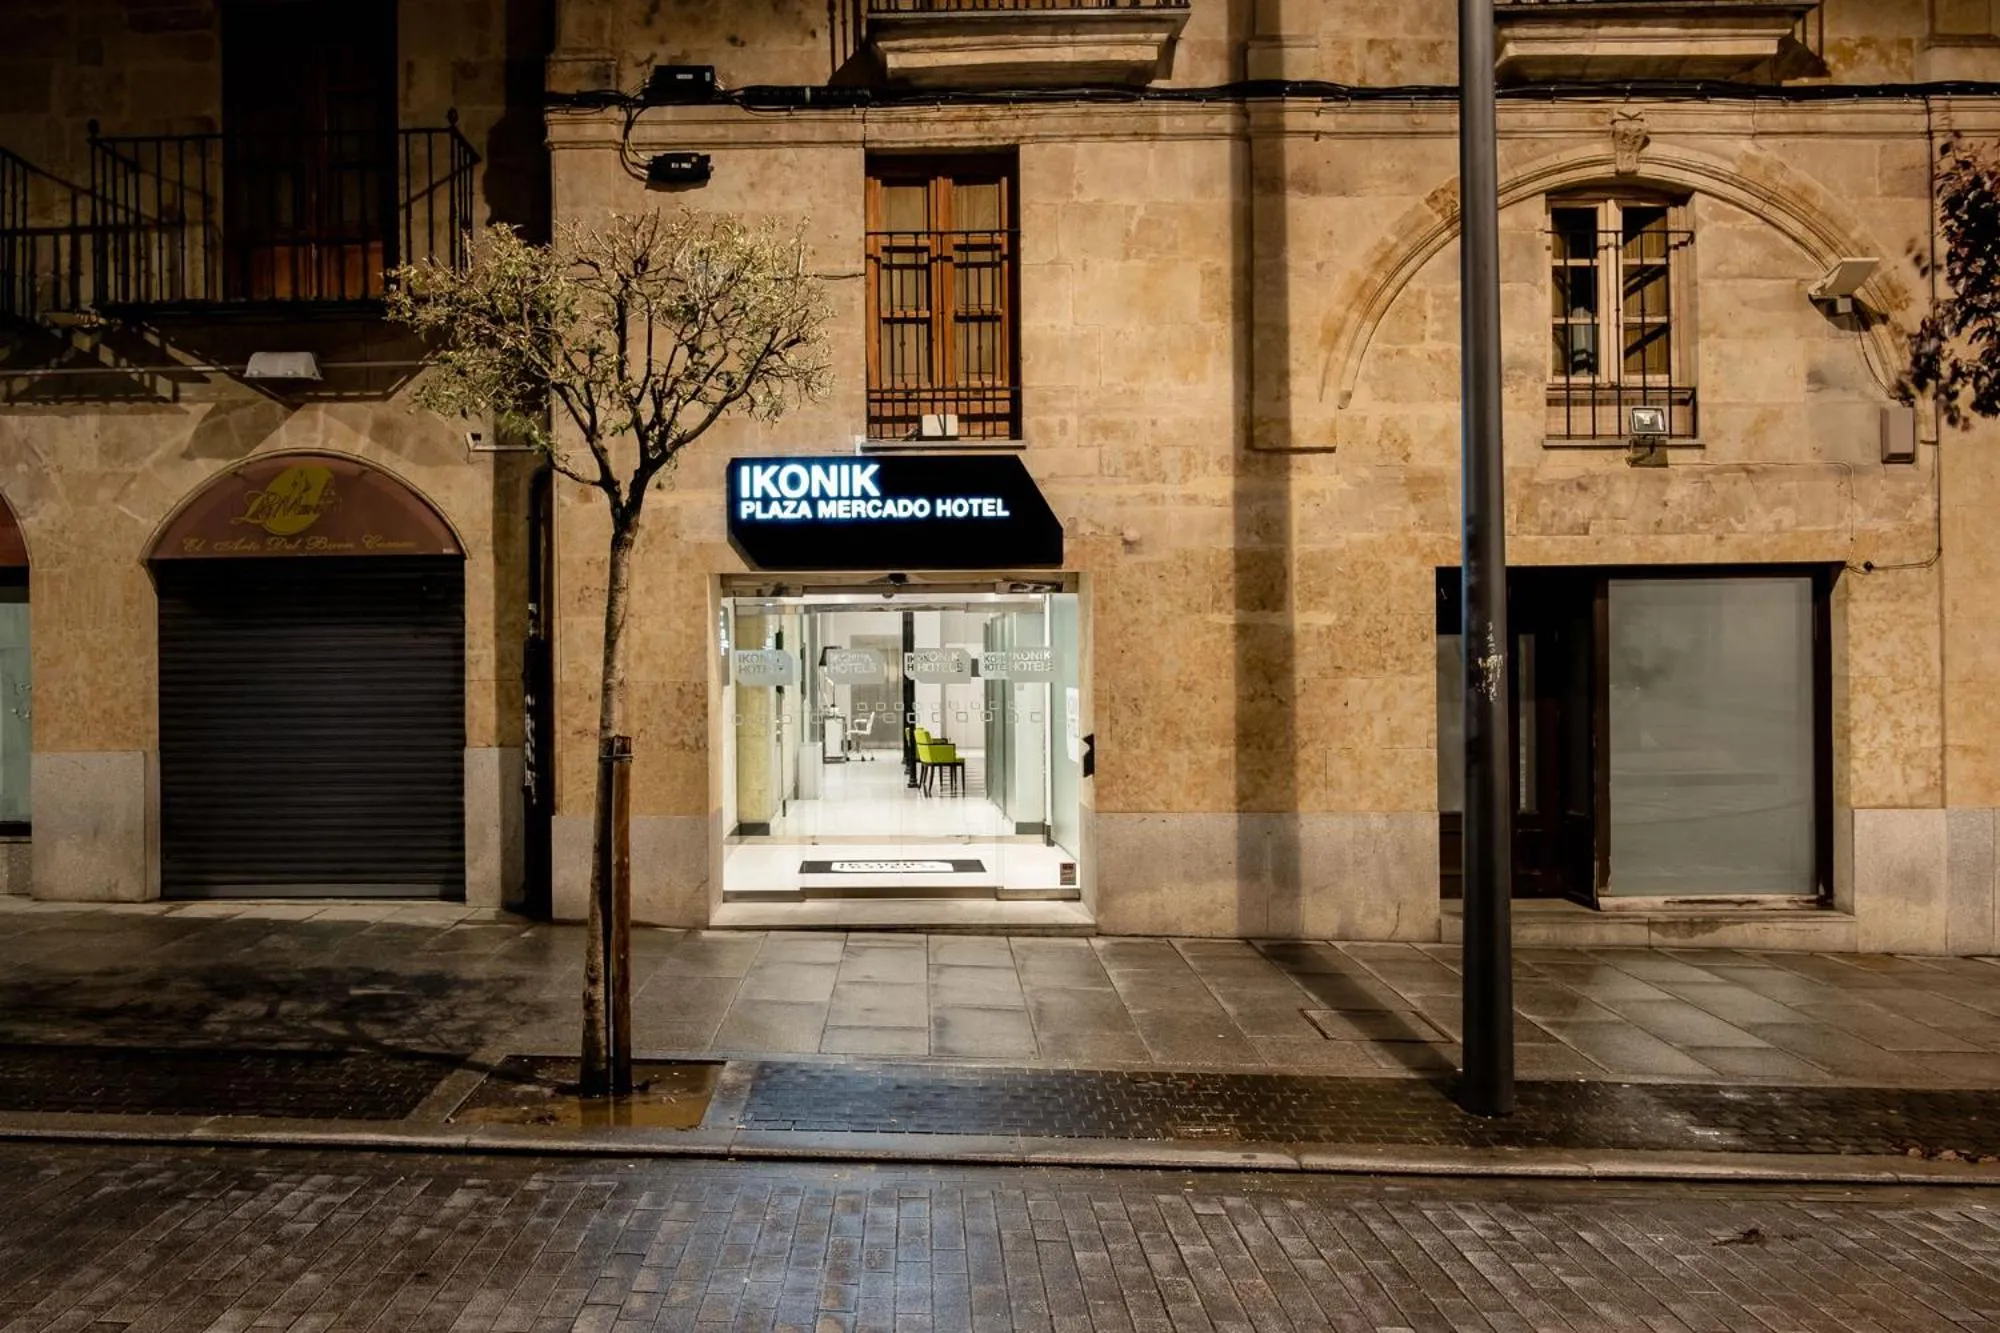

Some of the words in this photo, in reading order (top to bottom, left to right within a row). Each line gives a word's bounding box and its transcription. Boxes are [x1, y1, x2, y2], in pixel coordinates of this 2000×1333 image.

[740, 463, 881, 498] IKONIK
[740, 500, 813, 519] PLAZA
[817, 499, 932, 519] MERCADO
[936, 498, 1010, 517] HOTEL
[830, 663, 877, 674] HOTELS
